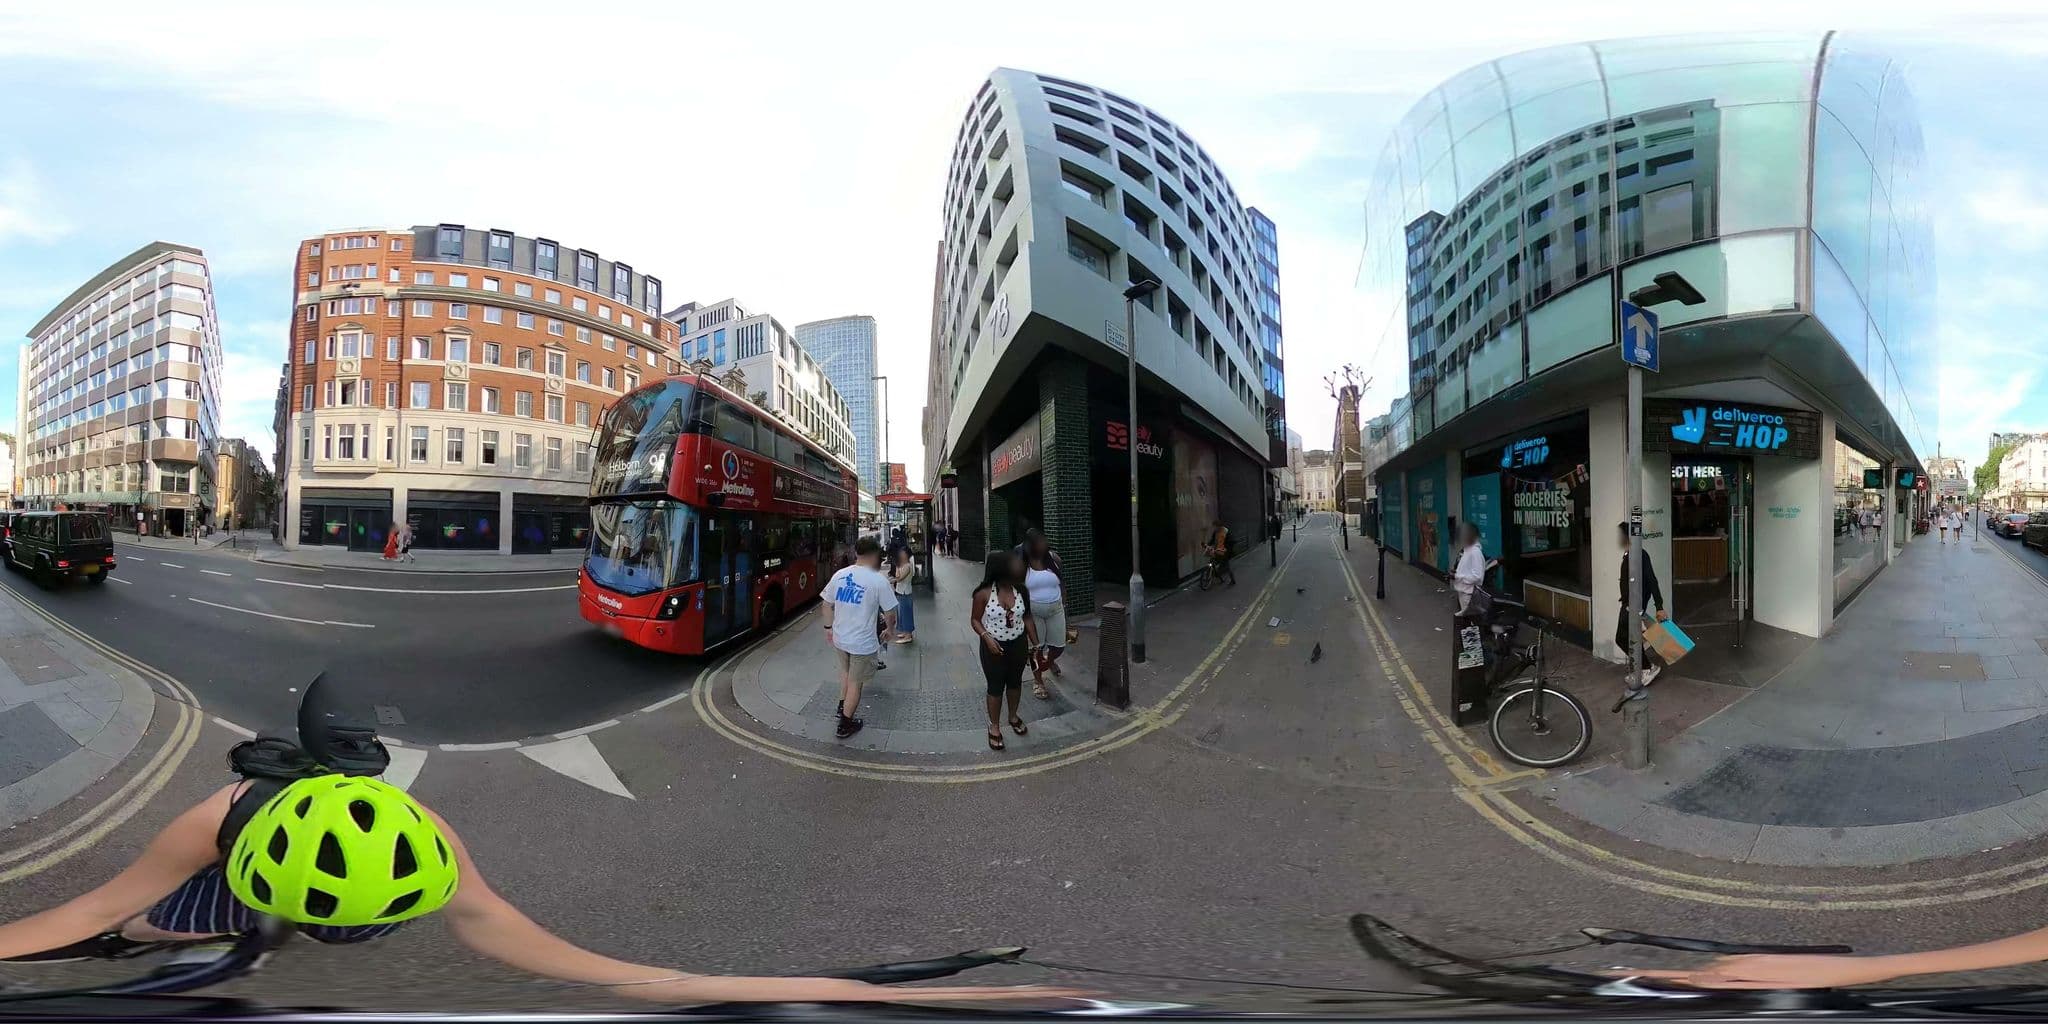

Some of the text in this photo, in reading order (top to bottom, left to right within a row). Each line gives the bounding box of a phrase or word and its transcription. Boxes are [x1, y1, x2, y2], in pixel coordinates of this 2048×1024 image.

[1712, 407, 1784, 425] deliveroo
[1513, 436, 1547, 451] deliveroo
[1735, 424, 1789, 450] HOP
[1136, 442, 1163, 459] eauty
[1523, 445, 1550, 467] HOP
[1693, 465, 1722, 478] HERE
[722, 480, 755, 497] Metroline
[1514, 490, 1568, 508] GROCERIES
[1513, 511, 1570, 528] IN MINUTES
[598, 593, 623, 610] Metroline
[836, 587, 865, 604] NIKE
